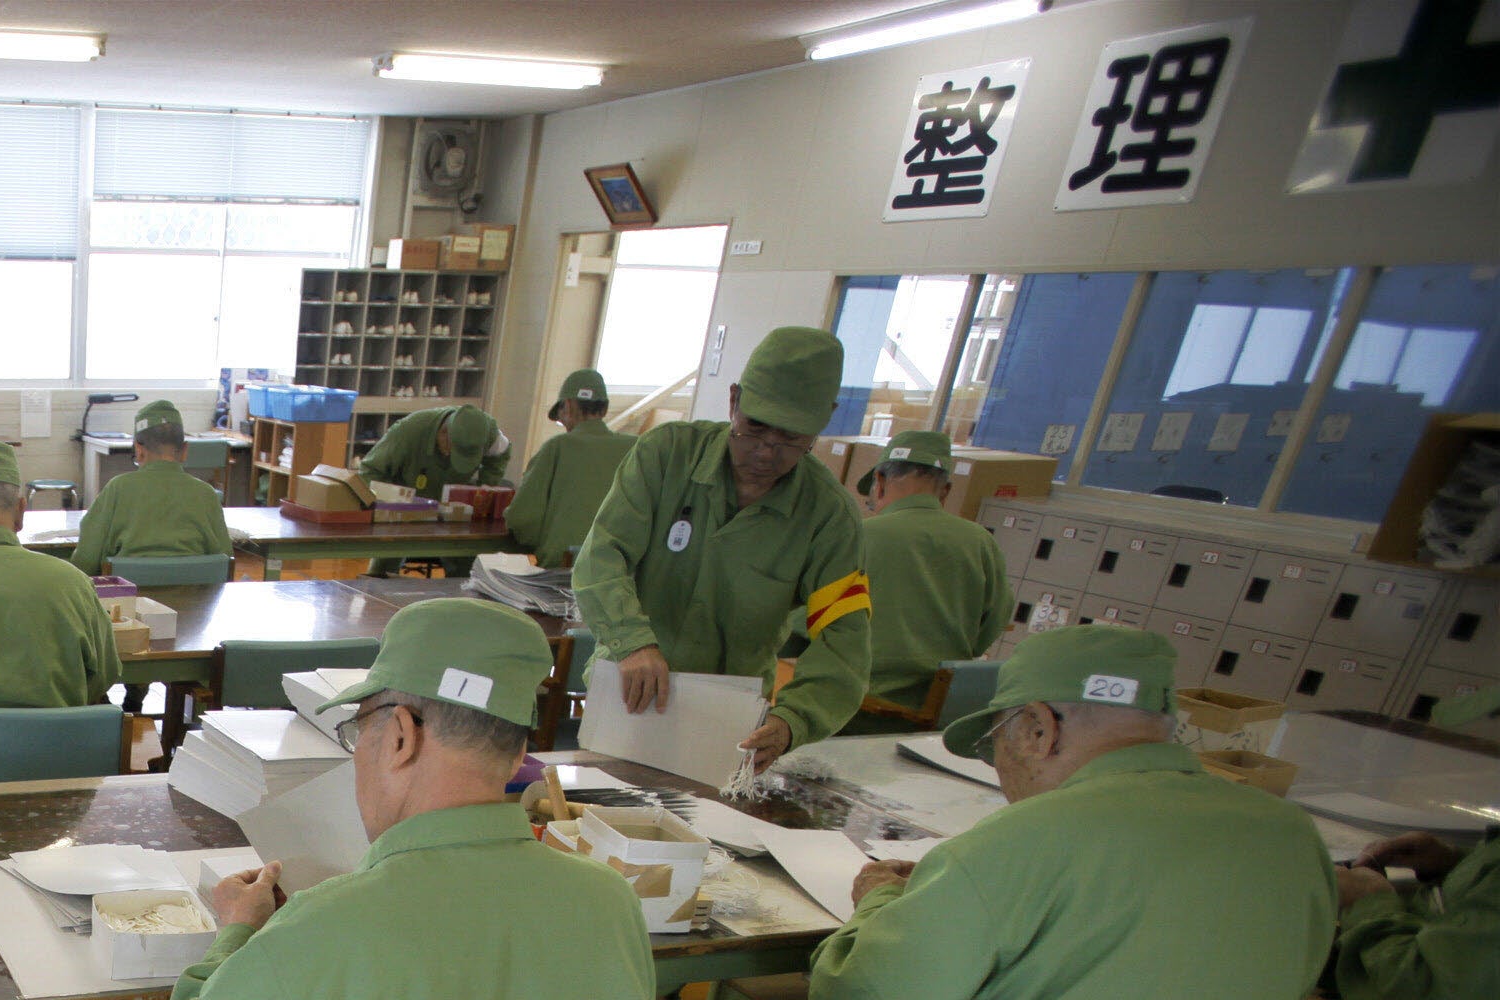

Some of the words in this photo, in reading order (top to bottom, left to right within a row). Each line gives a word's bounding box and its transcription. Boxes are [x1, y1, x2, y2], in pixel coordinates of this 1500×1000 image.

[892, 37, 1231, 210] 整理
[458, 678, 468, 697] 1
[1088, 678, 1126, 698] 20
